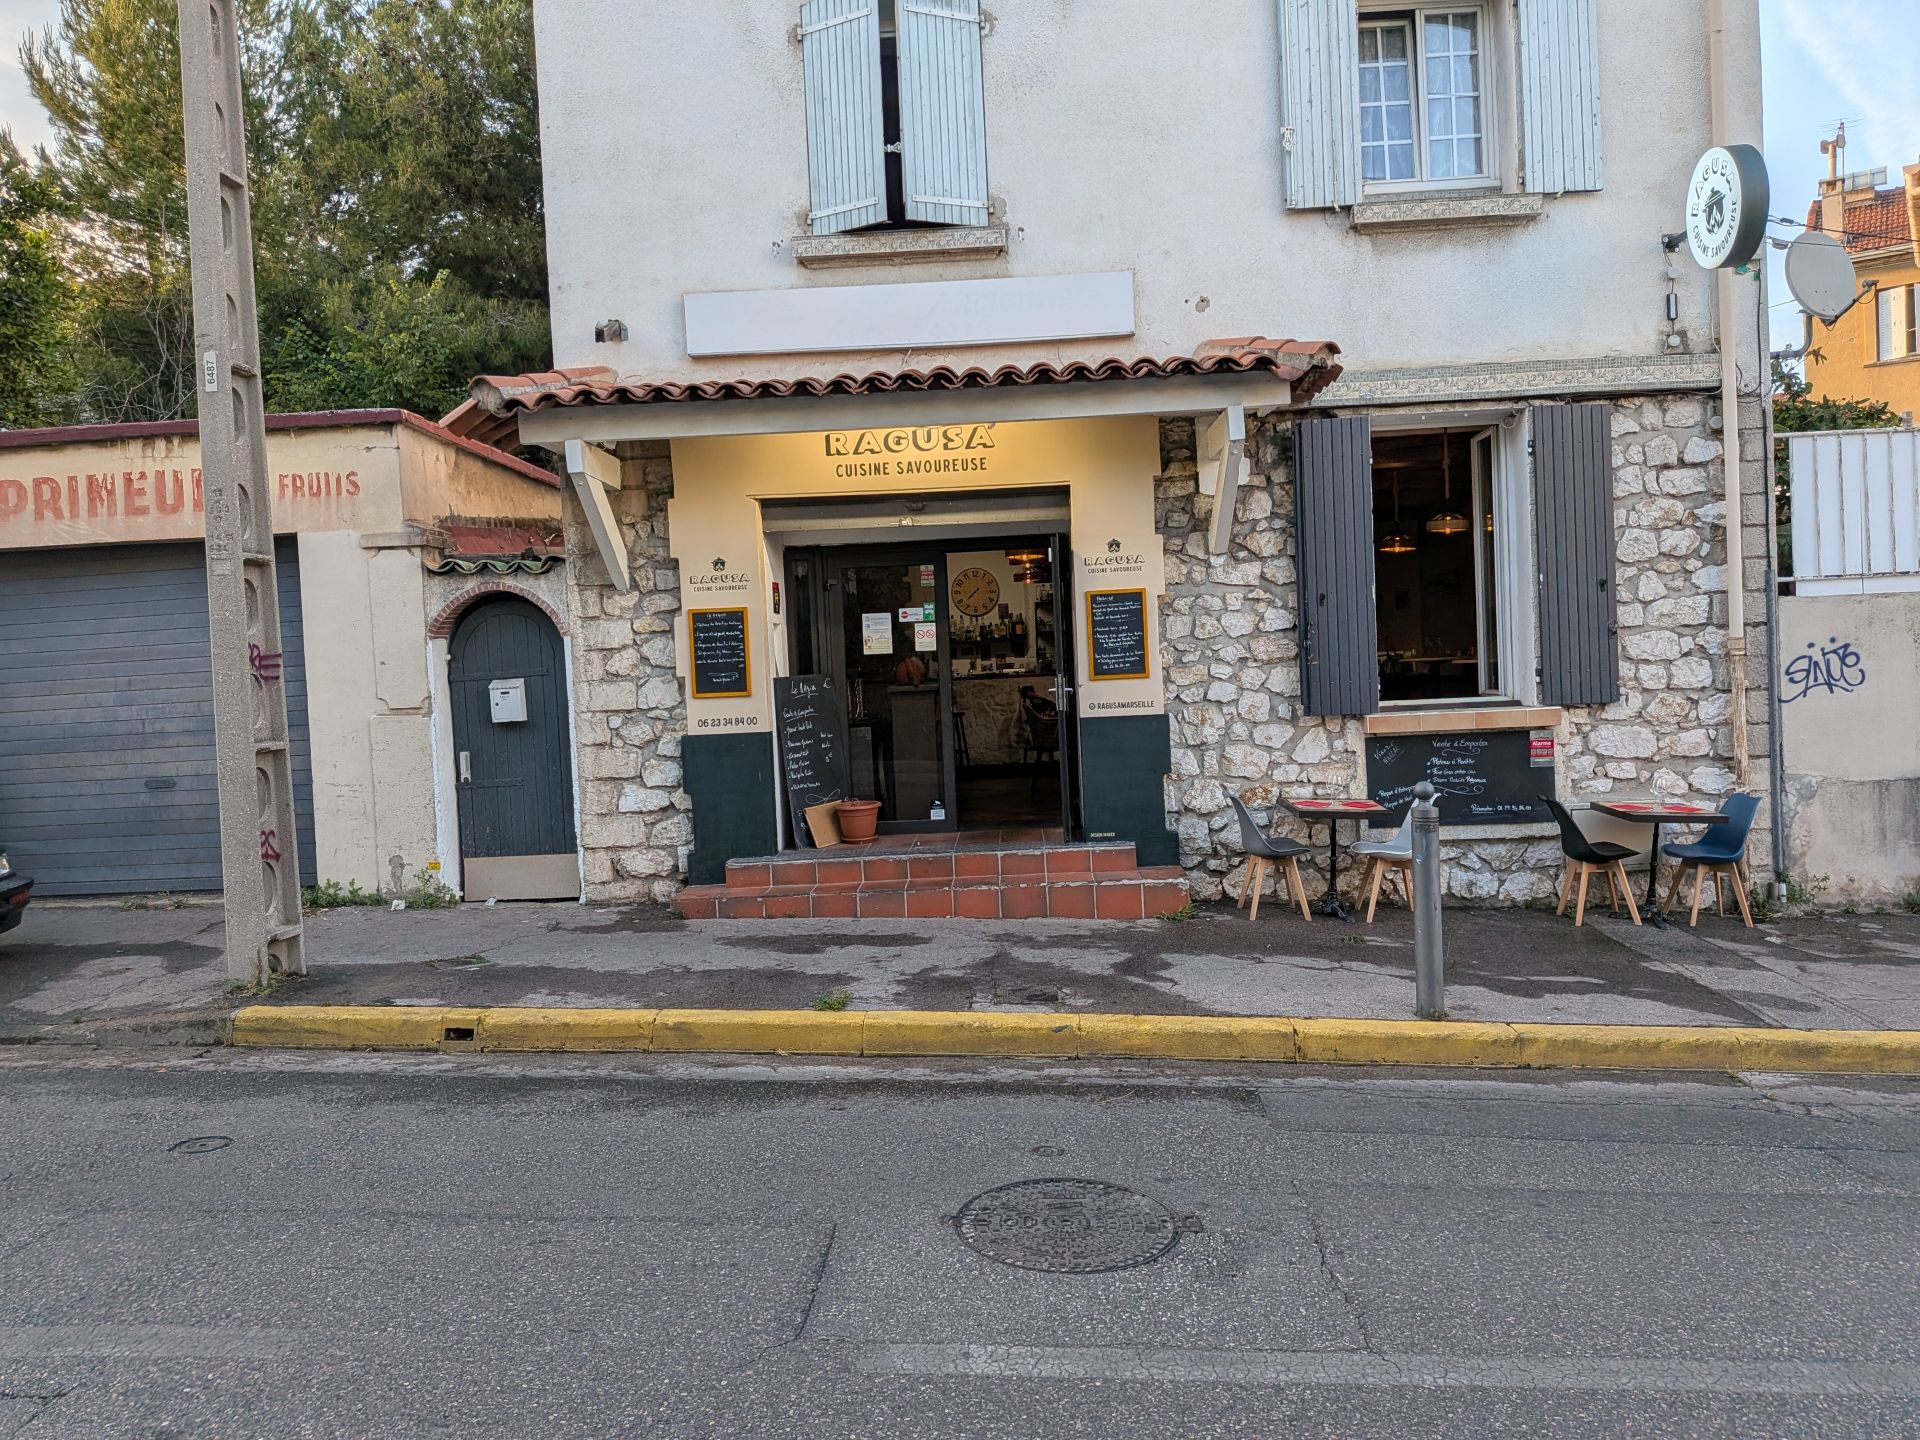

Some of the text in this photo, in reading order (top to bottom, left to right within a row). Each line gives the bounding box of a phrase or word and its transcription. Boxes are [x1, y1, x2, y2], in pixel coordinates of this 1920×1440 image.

[1691, 157, 1735, 217] RAGUSA
[1693, 198, 1738, 258] CUISINE SAVOUREUSE
[206, 360, 216, 384] 6487
[825, 425, 995, 456] RAGUSA
[836, 457, 987, 477] CUISINE SAVOUREUSE
[1084, 554, 1145, 566] RAGUSA
[690, 573, 750, 584] RAGUSA
[1097, 700, 1155, 709] RAGUSAMARSEILLE
[698, 716, 757, 727] 06 23 34 84 00
